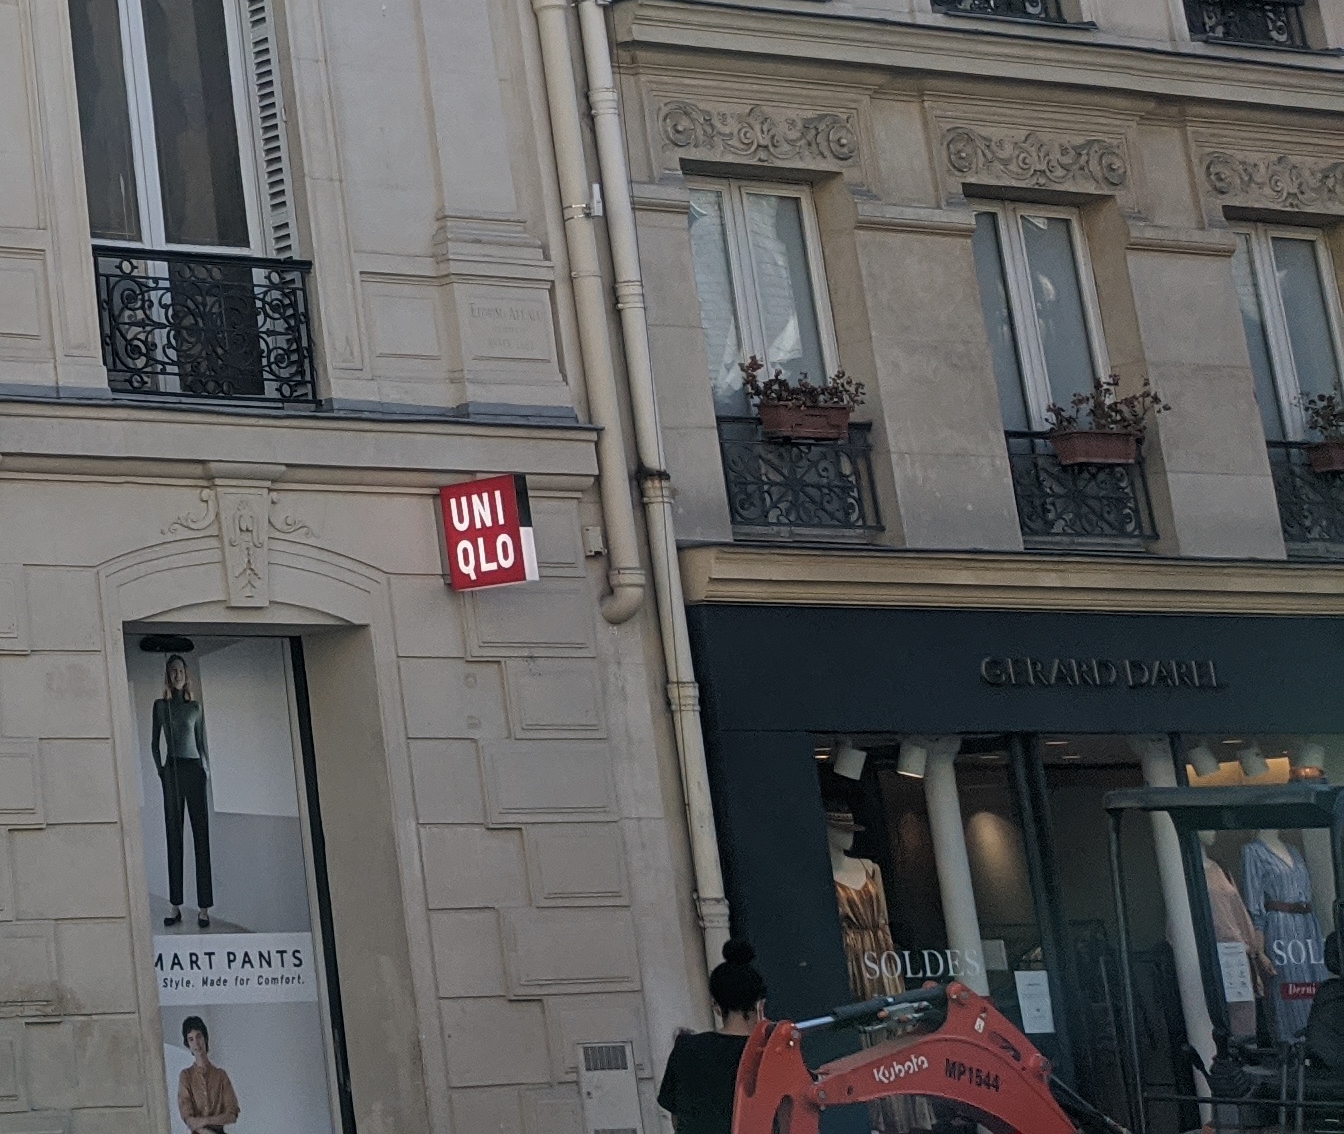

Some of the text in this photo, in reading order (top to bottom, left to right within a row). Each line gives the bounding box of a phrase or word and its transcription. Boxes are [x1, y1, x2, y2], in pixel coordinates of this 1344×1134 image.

[449, 489, 505, 532] UNI
[456, 533, 515, 581] QLO
[226, 949, 304, 970] PANTS
[863, 949, 982, 980] SOLDES
[162, 973, 305, 990] Style. Made for Comfort.
[872, 1053, 929, 1084] Kubota
